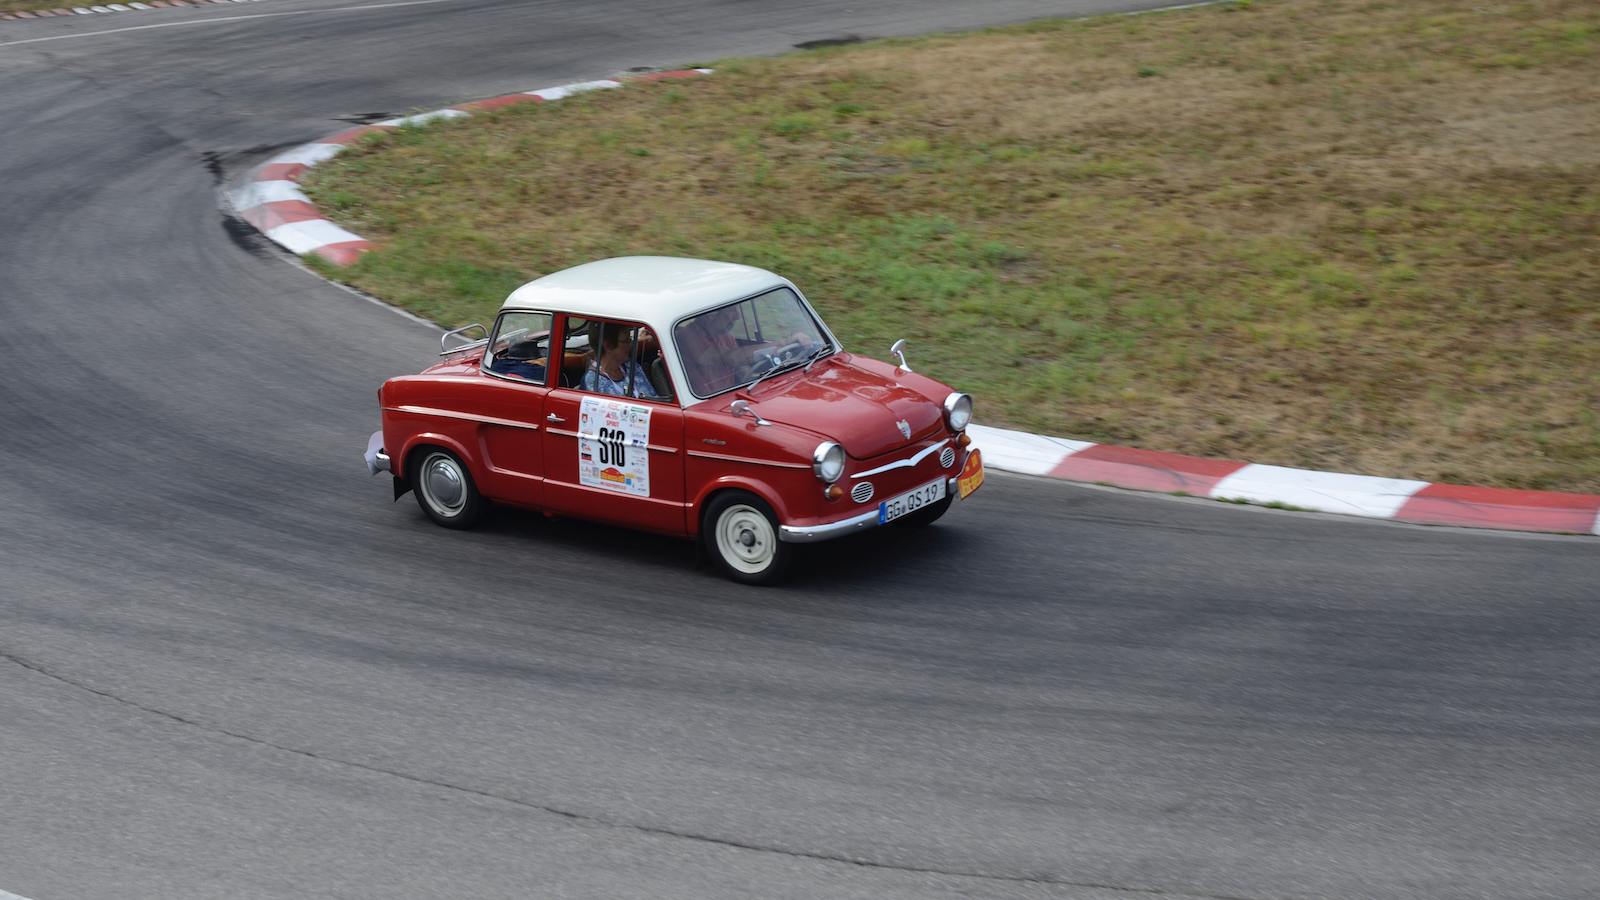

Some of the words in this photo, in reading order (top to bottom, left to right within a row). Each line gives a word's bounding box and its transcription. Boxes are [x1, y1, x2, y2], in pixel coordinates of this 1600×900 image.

[886, 501, 900, 520] GG
[908, 491, 921, 511] QS
[925, 484, 938, 503] 19
